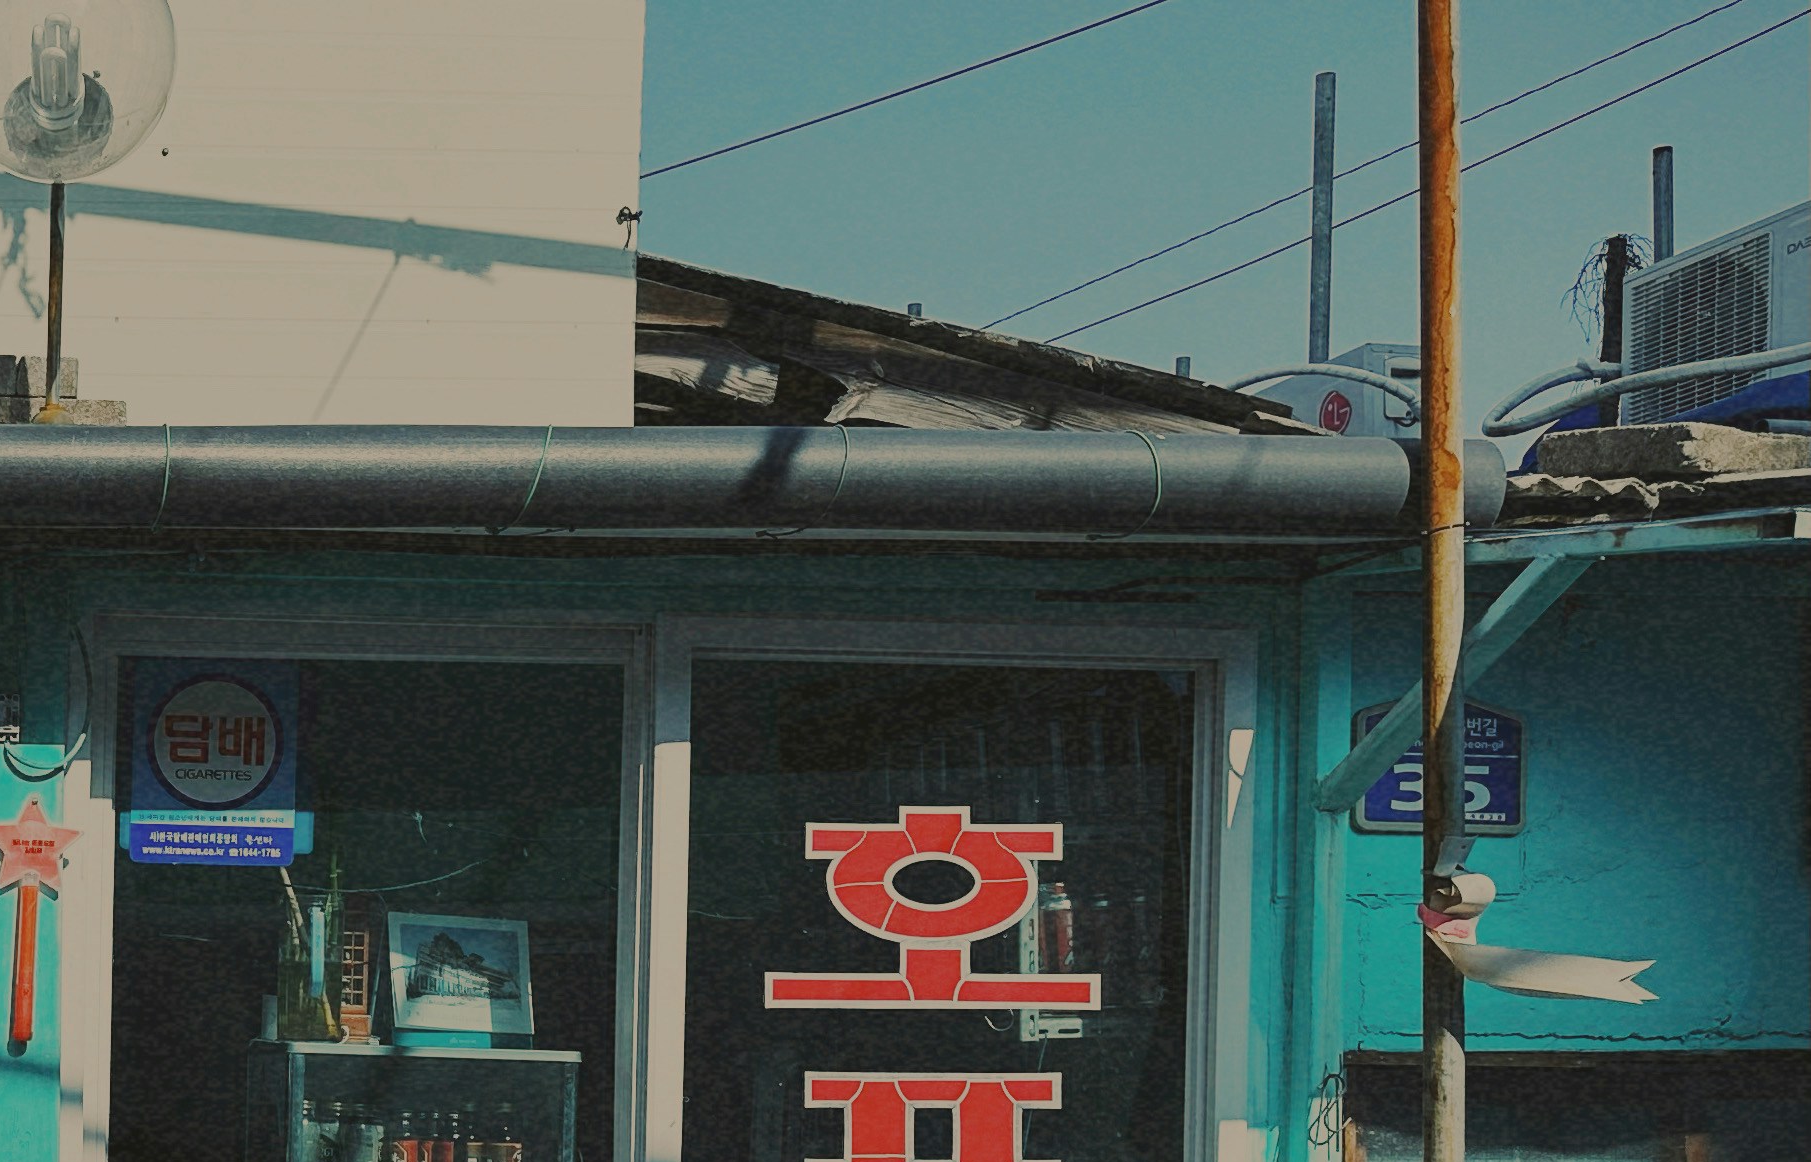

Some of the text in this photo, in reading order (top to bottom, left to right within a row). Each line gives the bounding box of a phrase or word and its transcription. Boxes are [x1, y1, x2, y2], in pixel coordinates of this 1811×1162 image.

[1464, 717, 1497, 737] 번길
[165, 715, 267, 766] 담배
[1464, 739, 1504, 751] eon-gil
[175, 768, 252, 781] CIGARETTES
